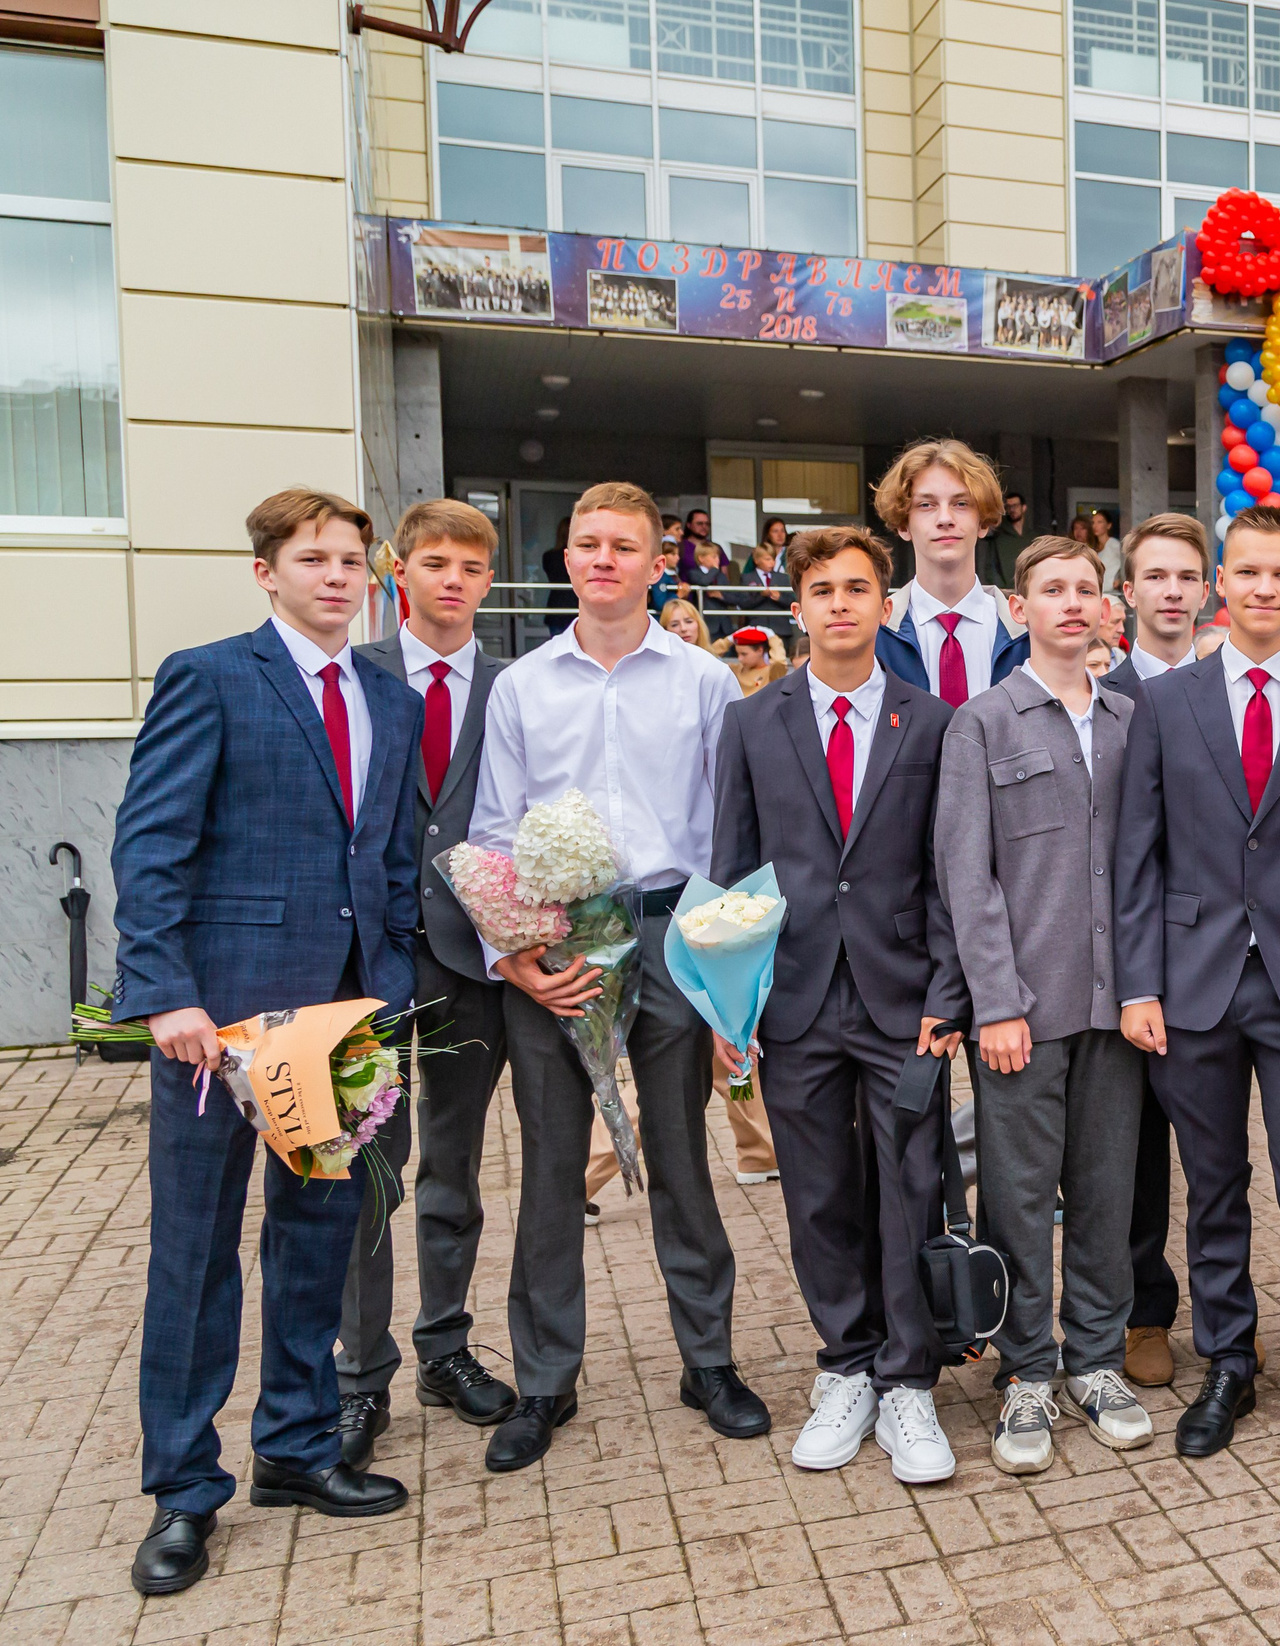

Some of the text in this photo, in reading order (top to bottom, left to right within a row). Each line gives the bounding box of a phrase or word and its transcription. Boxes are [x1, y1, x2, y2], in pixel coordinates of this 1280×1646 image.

[597, 238, 963, 298] ПОЗДРАВЛЯЕМ
[774, 286, 796, 313] И
[759, 313, 817, 341] 2018
